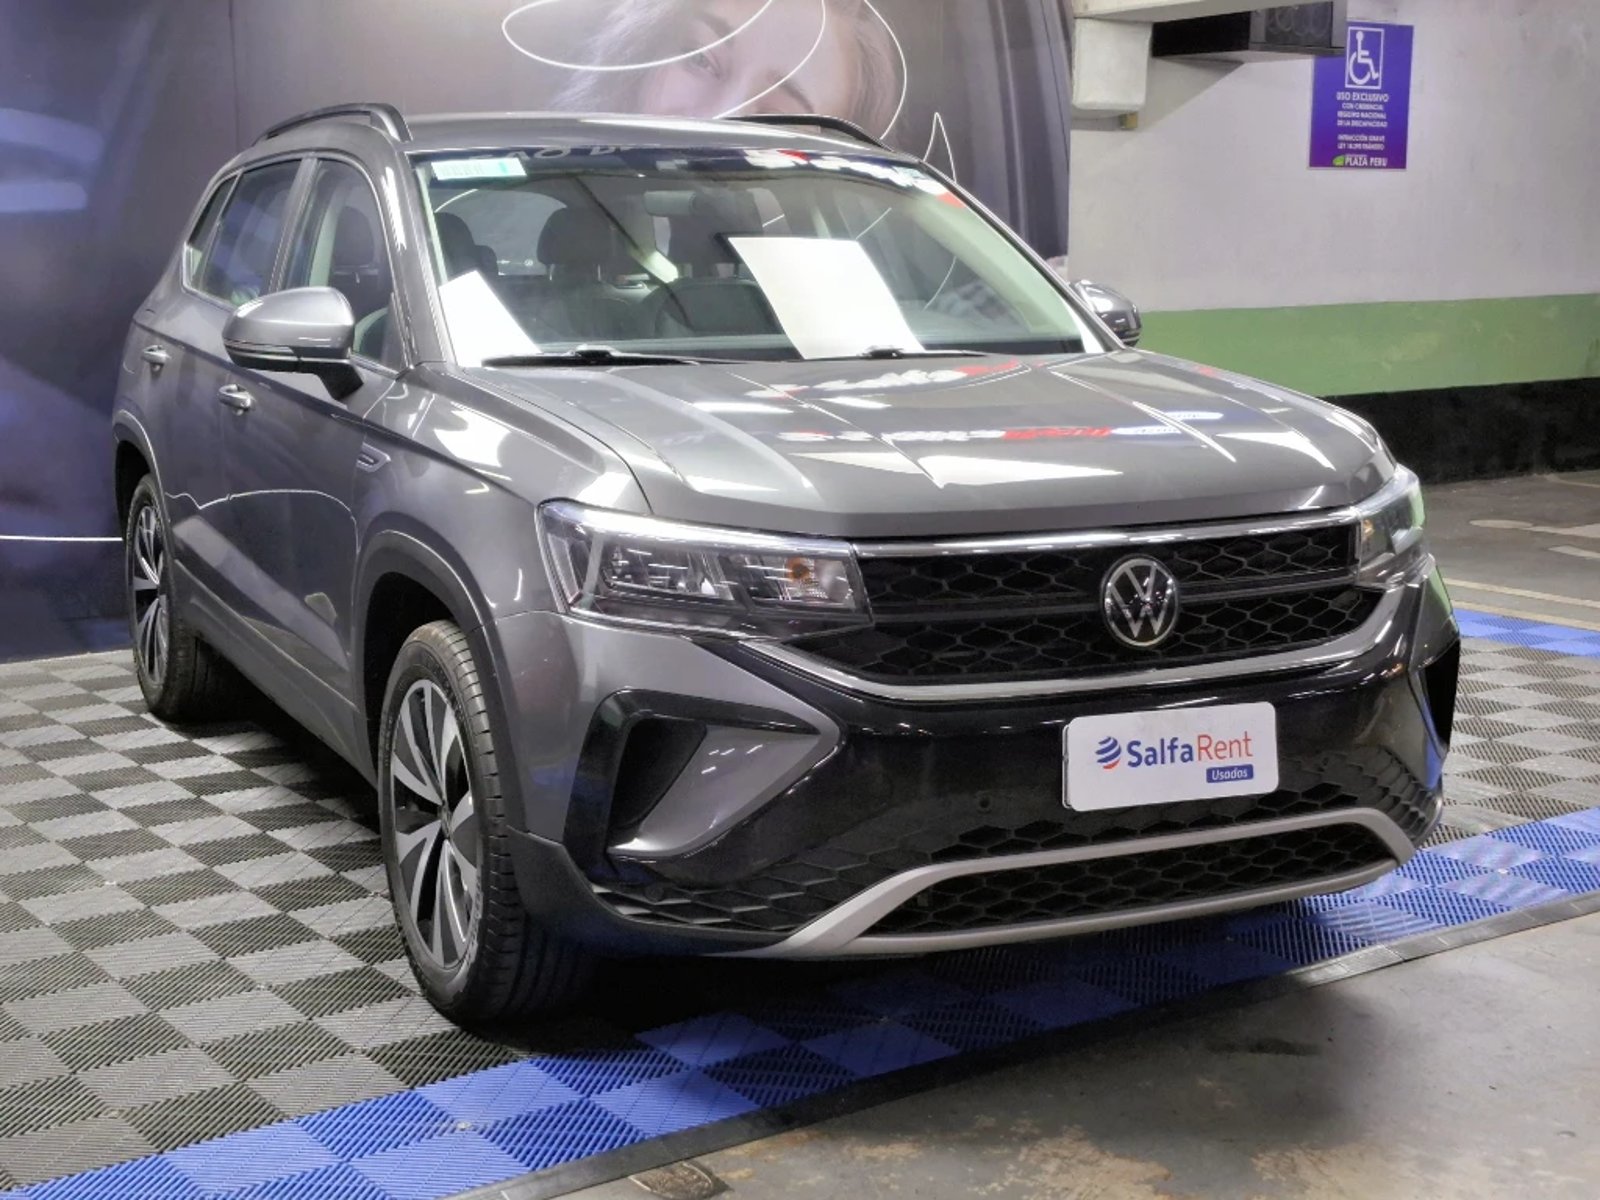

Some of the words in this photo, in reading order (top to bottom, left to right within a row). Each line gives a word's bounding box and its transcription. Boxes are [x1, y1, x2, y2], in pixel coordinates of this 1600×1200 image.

[1345, 156, 1368, 167] PLAZA
[1369, 157, 1388, 167] PERU
[1127, 731, 1253, 768] SalfaRent
[1211, 766, 1249, 781] Usados
